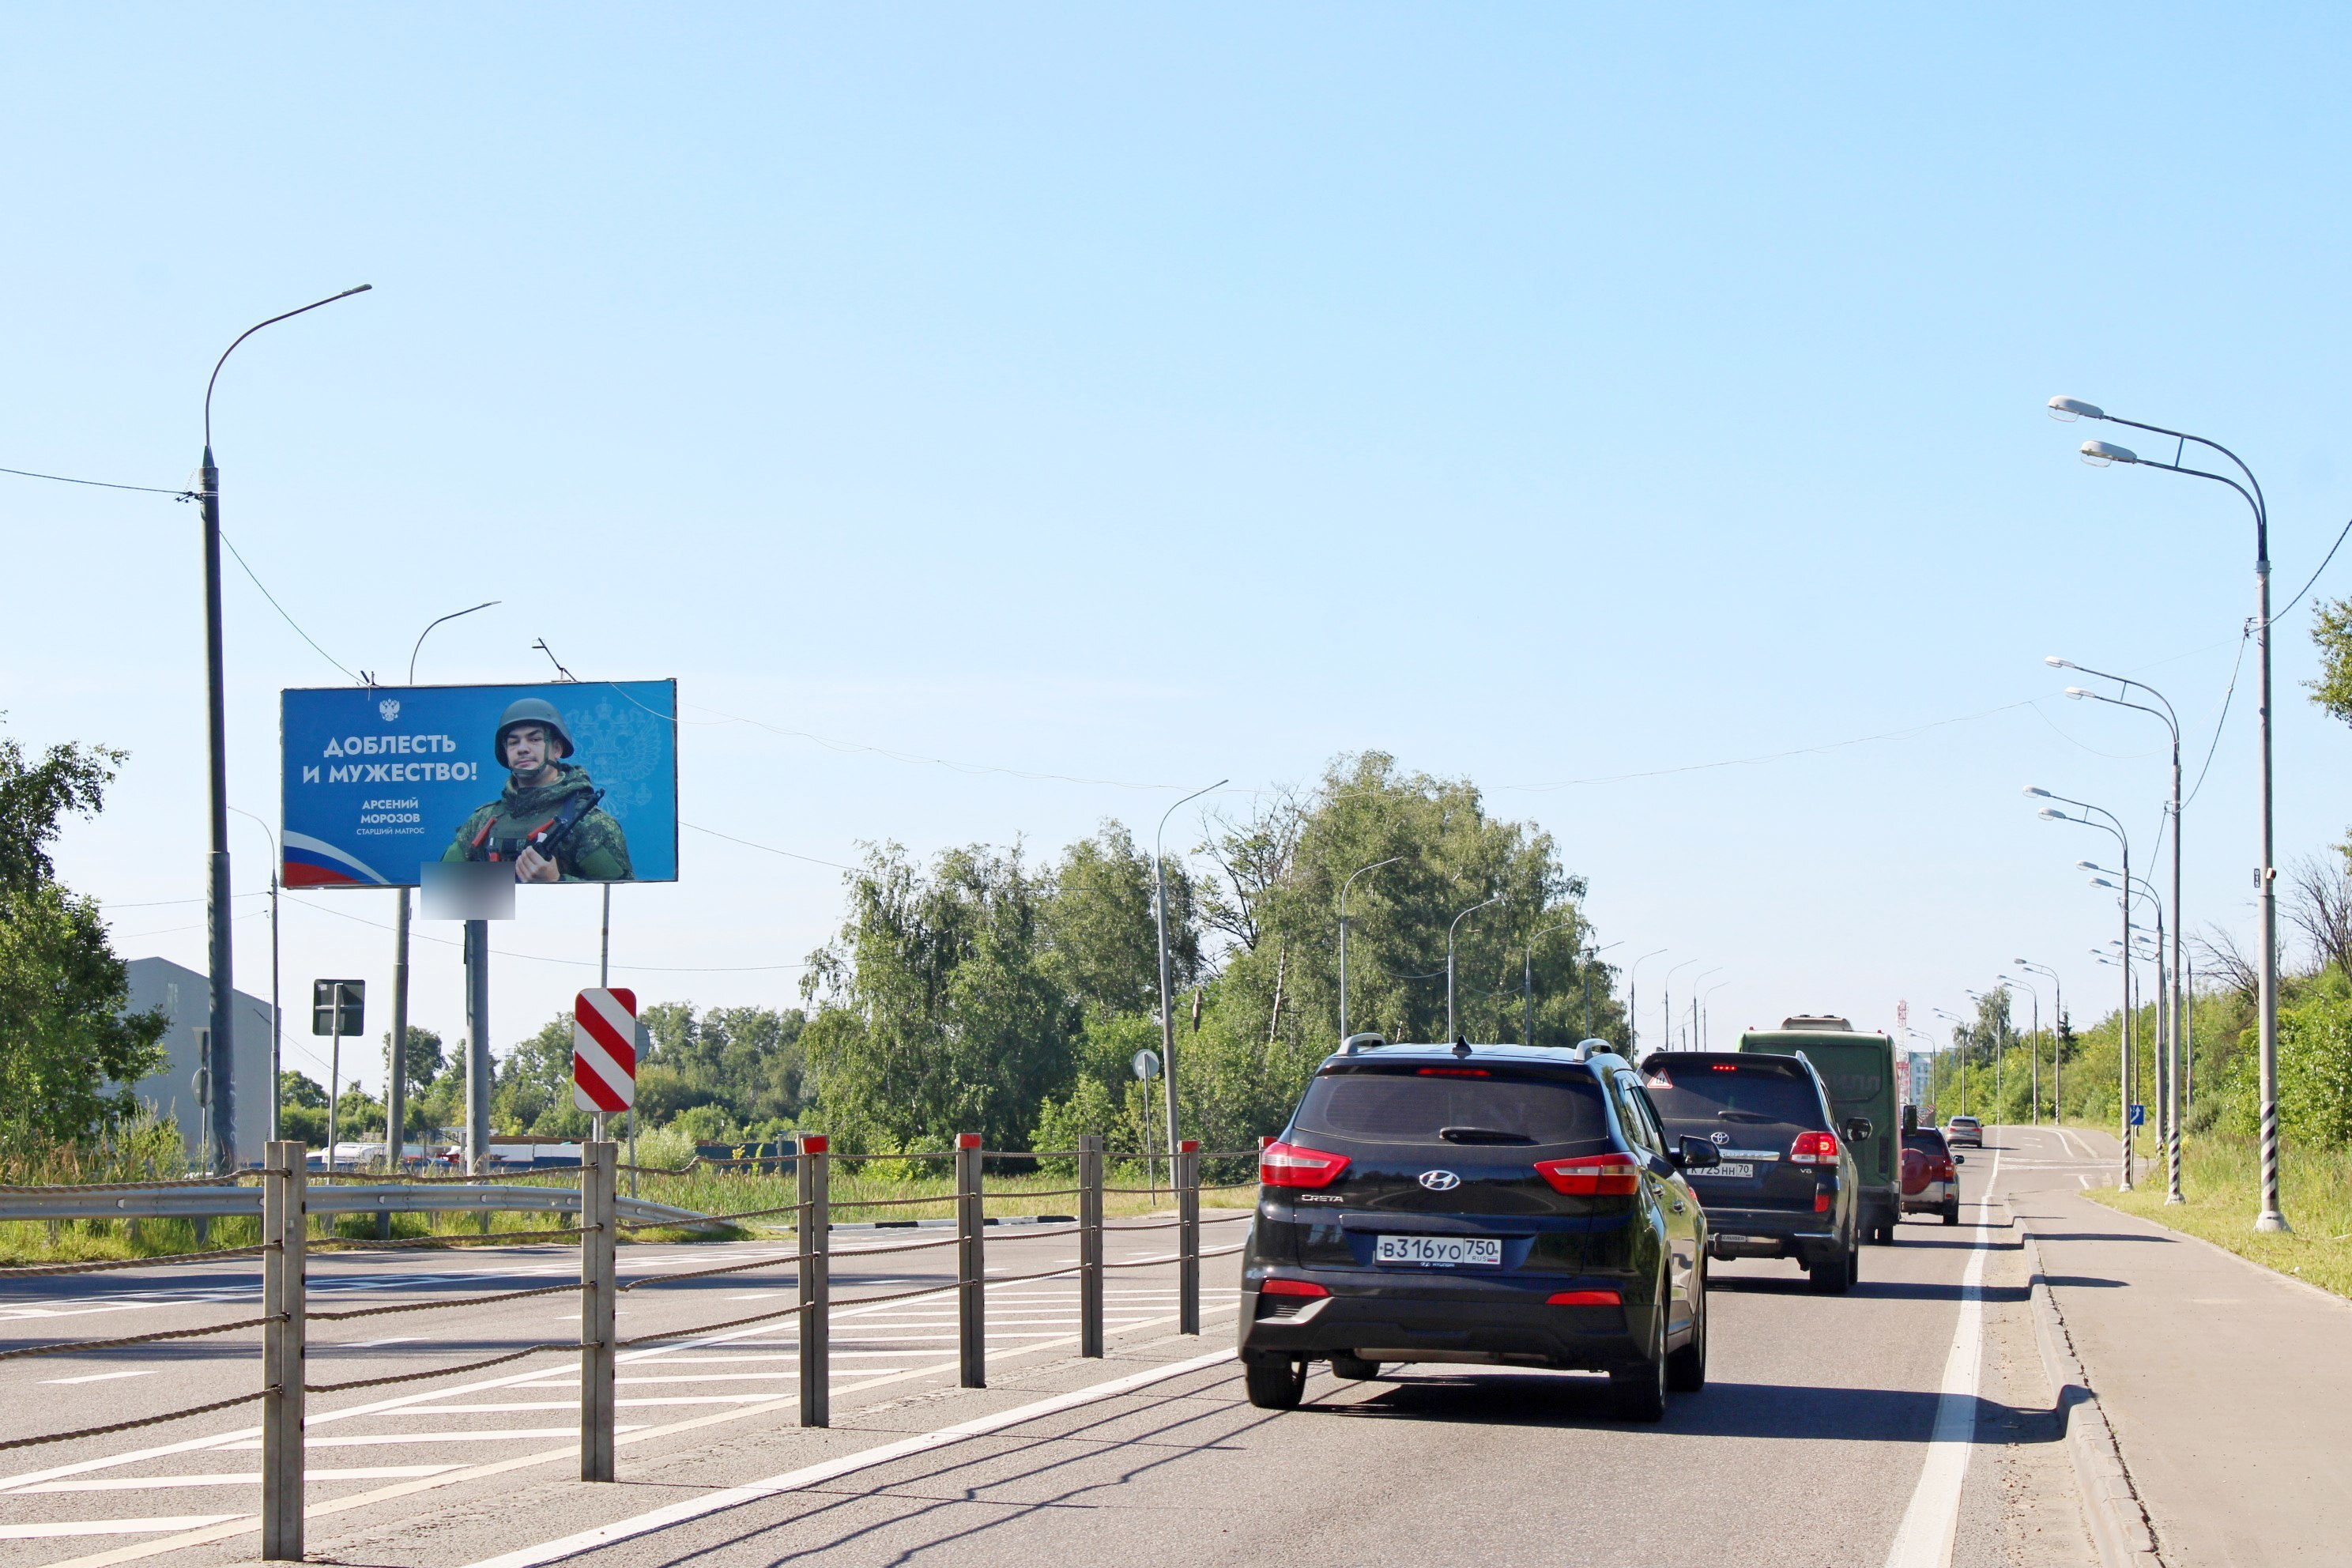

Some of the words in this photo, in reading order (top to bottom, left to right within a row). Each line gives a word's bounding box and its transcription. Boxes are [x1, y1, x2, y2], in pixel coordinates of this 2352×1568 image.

[323, 735, 456, 758] ДОБЛЕСТЬ
[303, 765, 320, 784] И
[328, 762, 477, 783] МУЖЕСТВО!
[361, 797, 419, 810] АРСЕНИЙ
[360, 813, 420, 824] МОРОЗОВ
[356, 827, 393, 835] СТАРШИЙ
[1738, 1164, 1749, 1174] 70
[1465, 1240, 1495, 1255] 750
